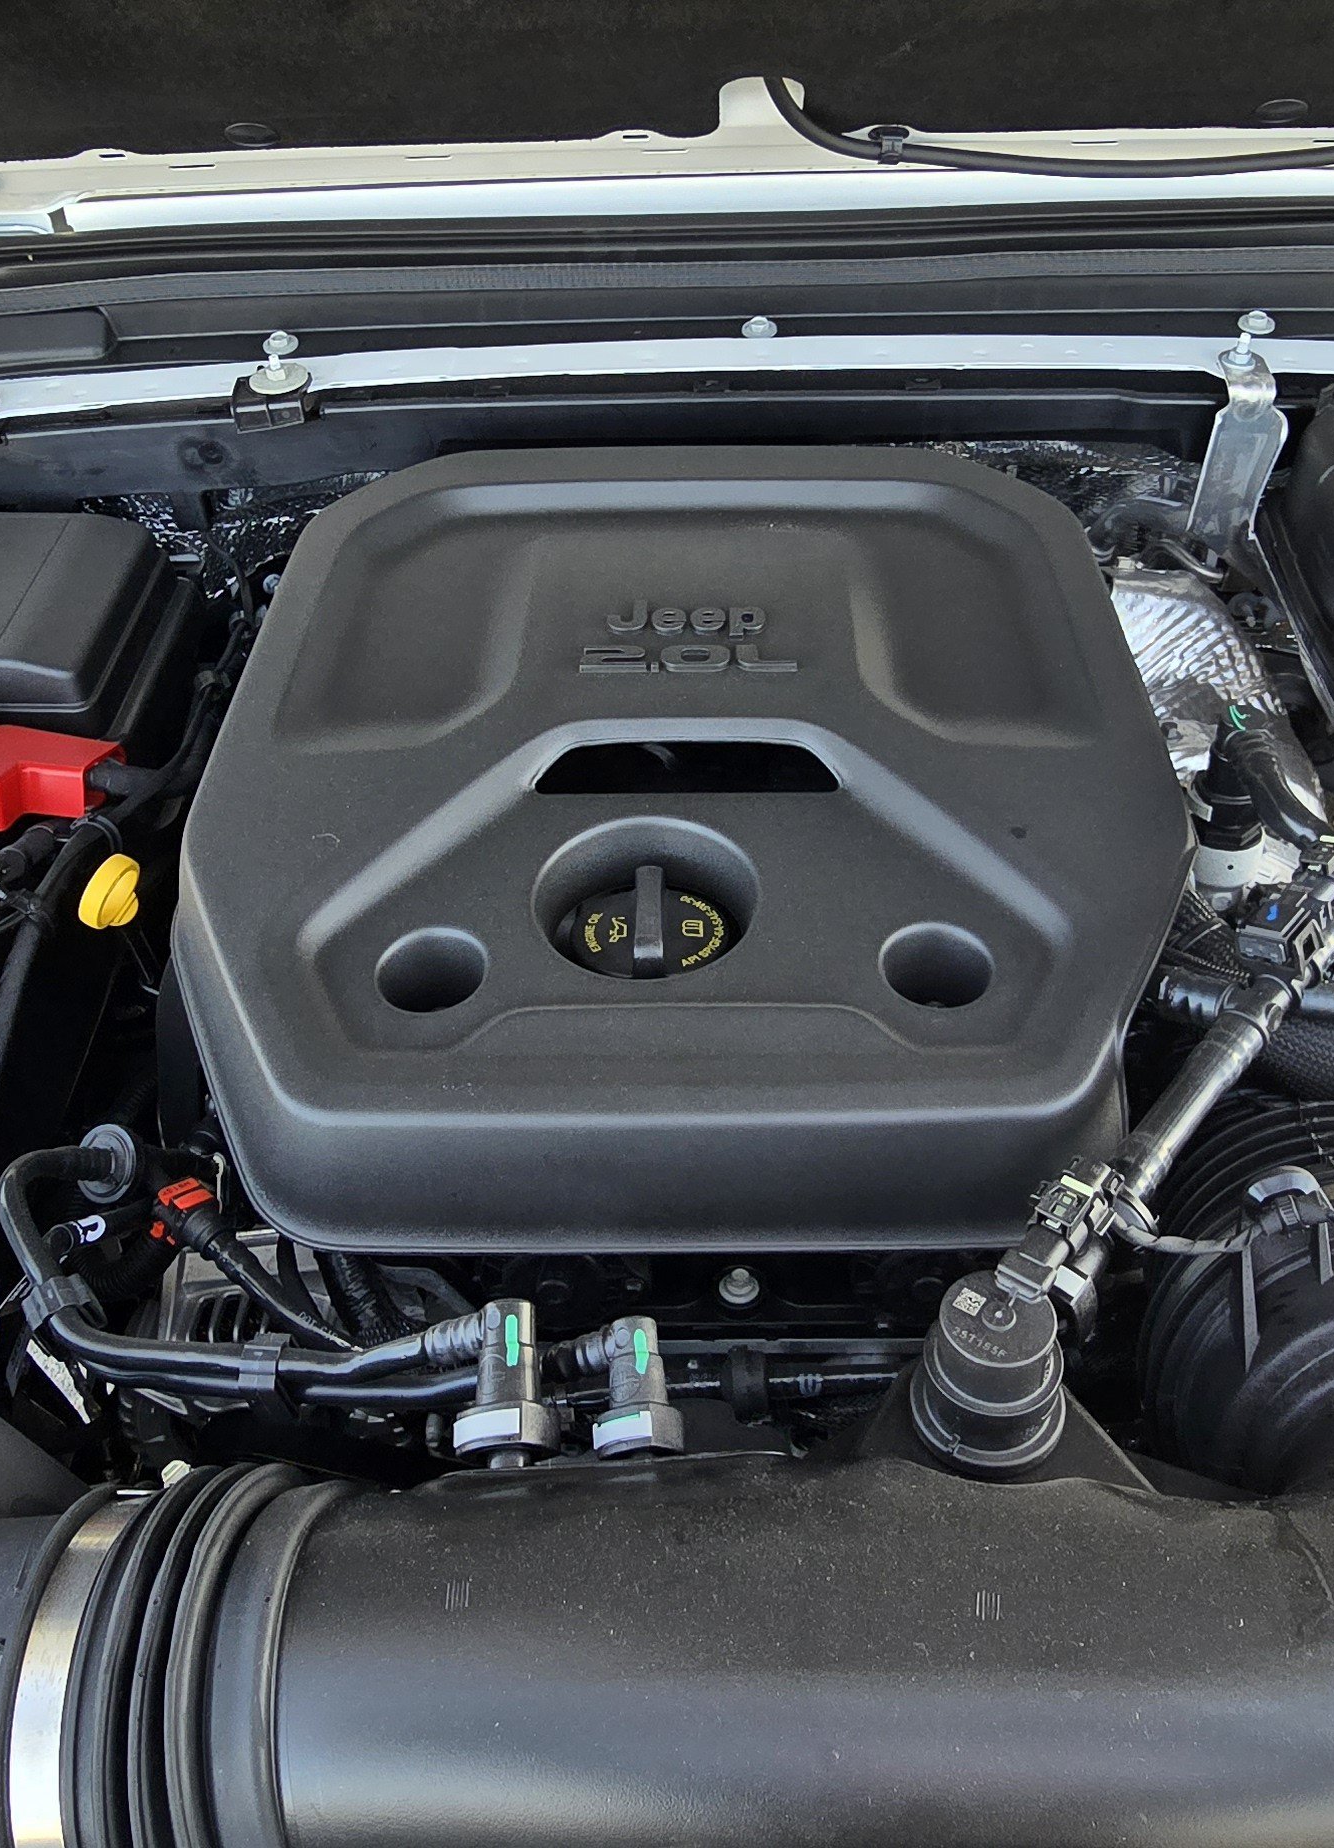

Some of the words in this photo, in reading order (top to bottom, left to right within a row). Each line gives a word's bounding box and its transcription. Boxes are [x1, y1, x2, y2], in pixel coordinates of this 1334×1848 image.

[606, 599, 766, 640] Jeep
[579, 645, 798, 673] 2.0L
[584, 924, 602, 953] ENGINE
[681, 954, 702, 967] API
